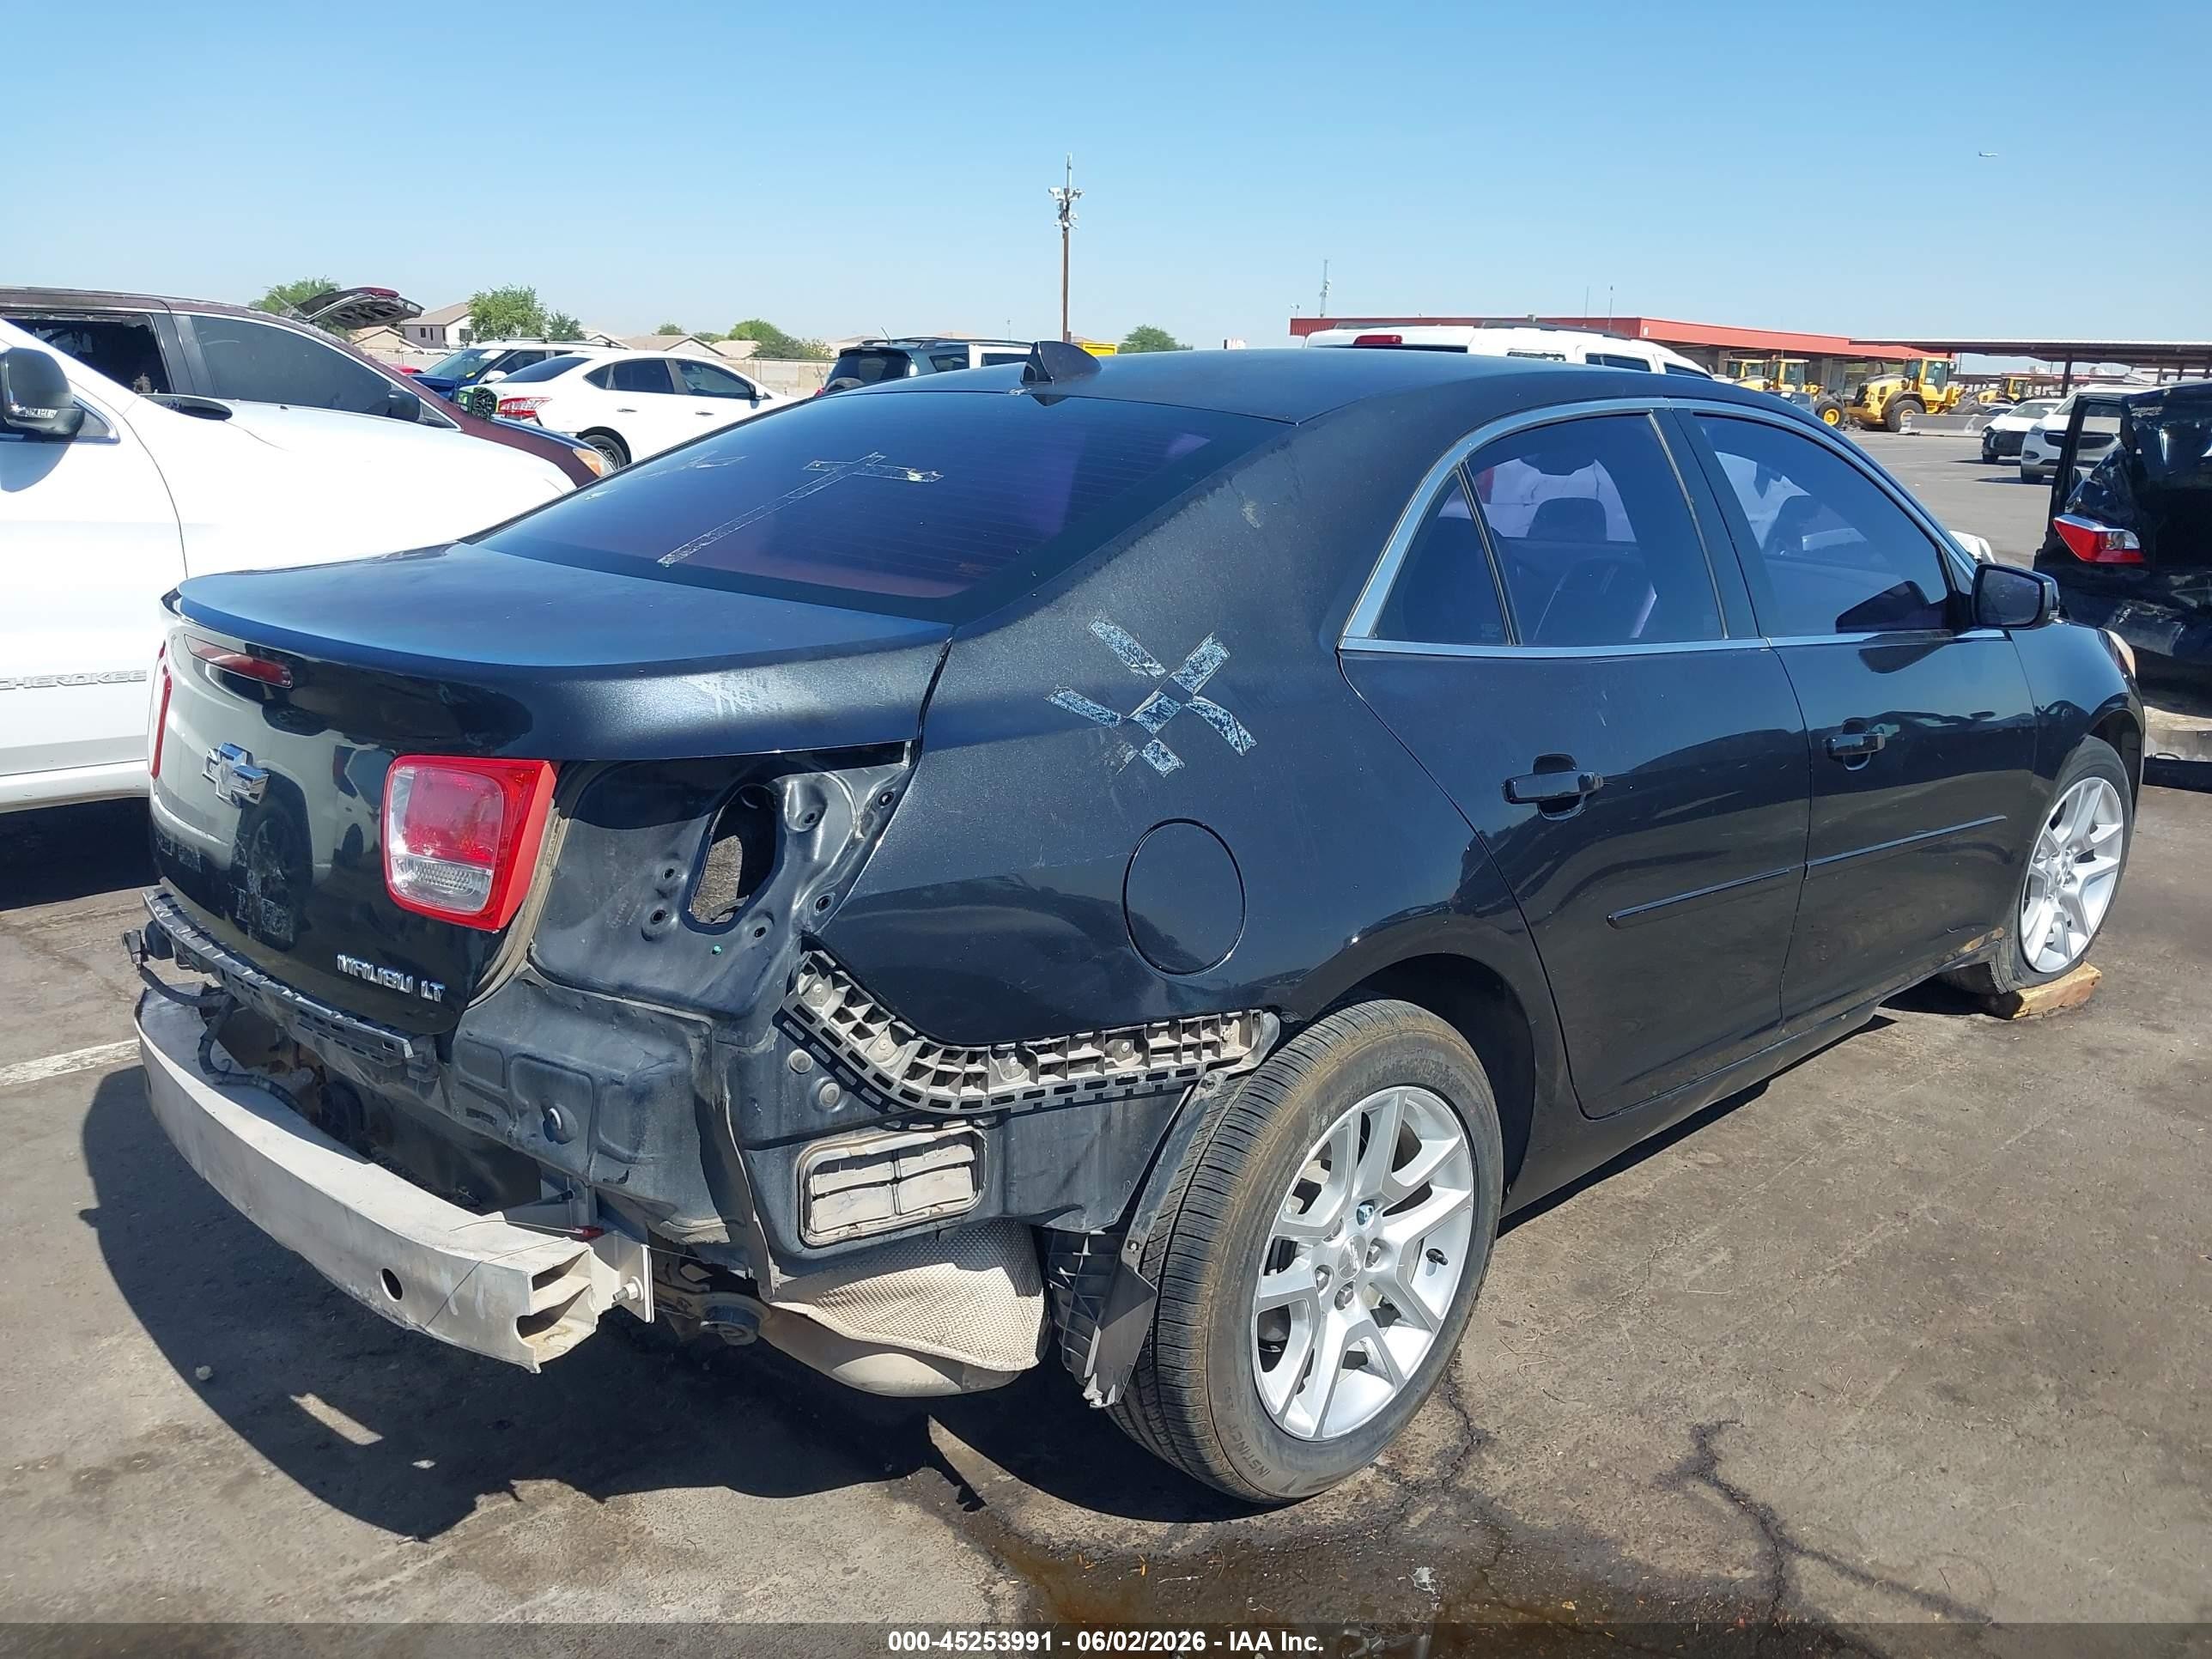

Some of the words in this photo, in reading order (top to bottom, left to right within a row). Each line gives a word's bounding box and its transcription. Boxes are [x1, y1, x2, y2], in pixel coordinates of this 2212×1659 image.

[1964, 416, 1977, 434] 6
[337, 954, 414, 994] MALIBU
[420, 980, 446, 1003] LT
